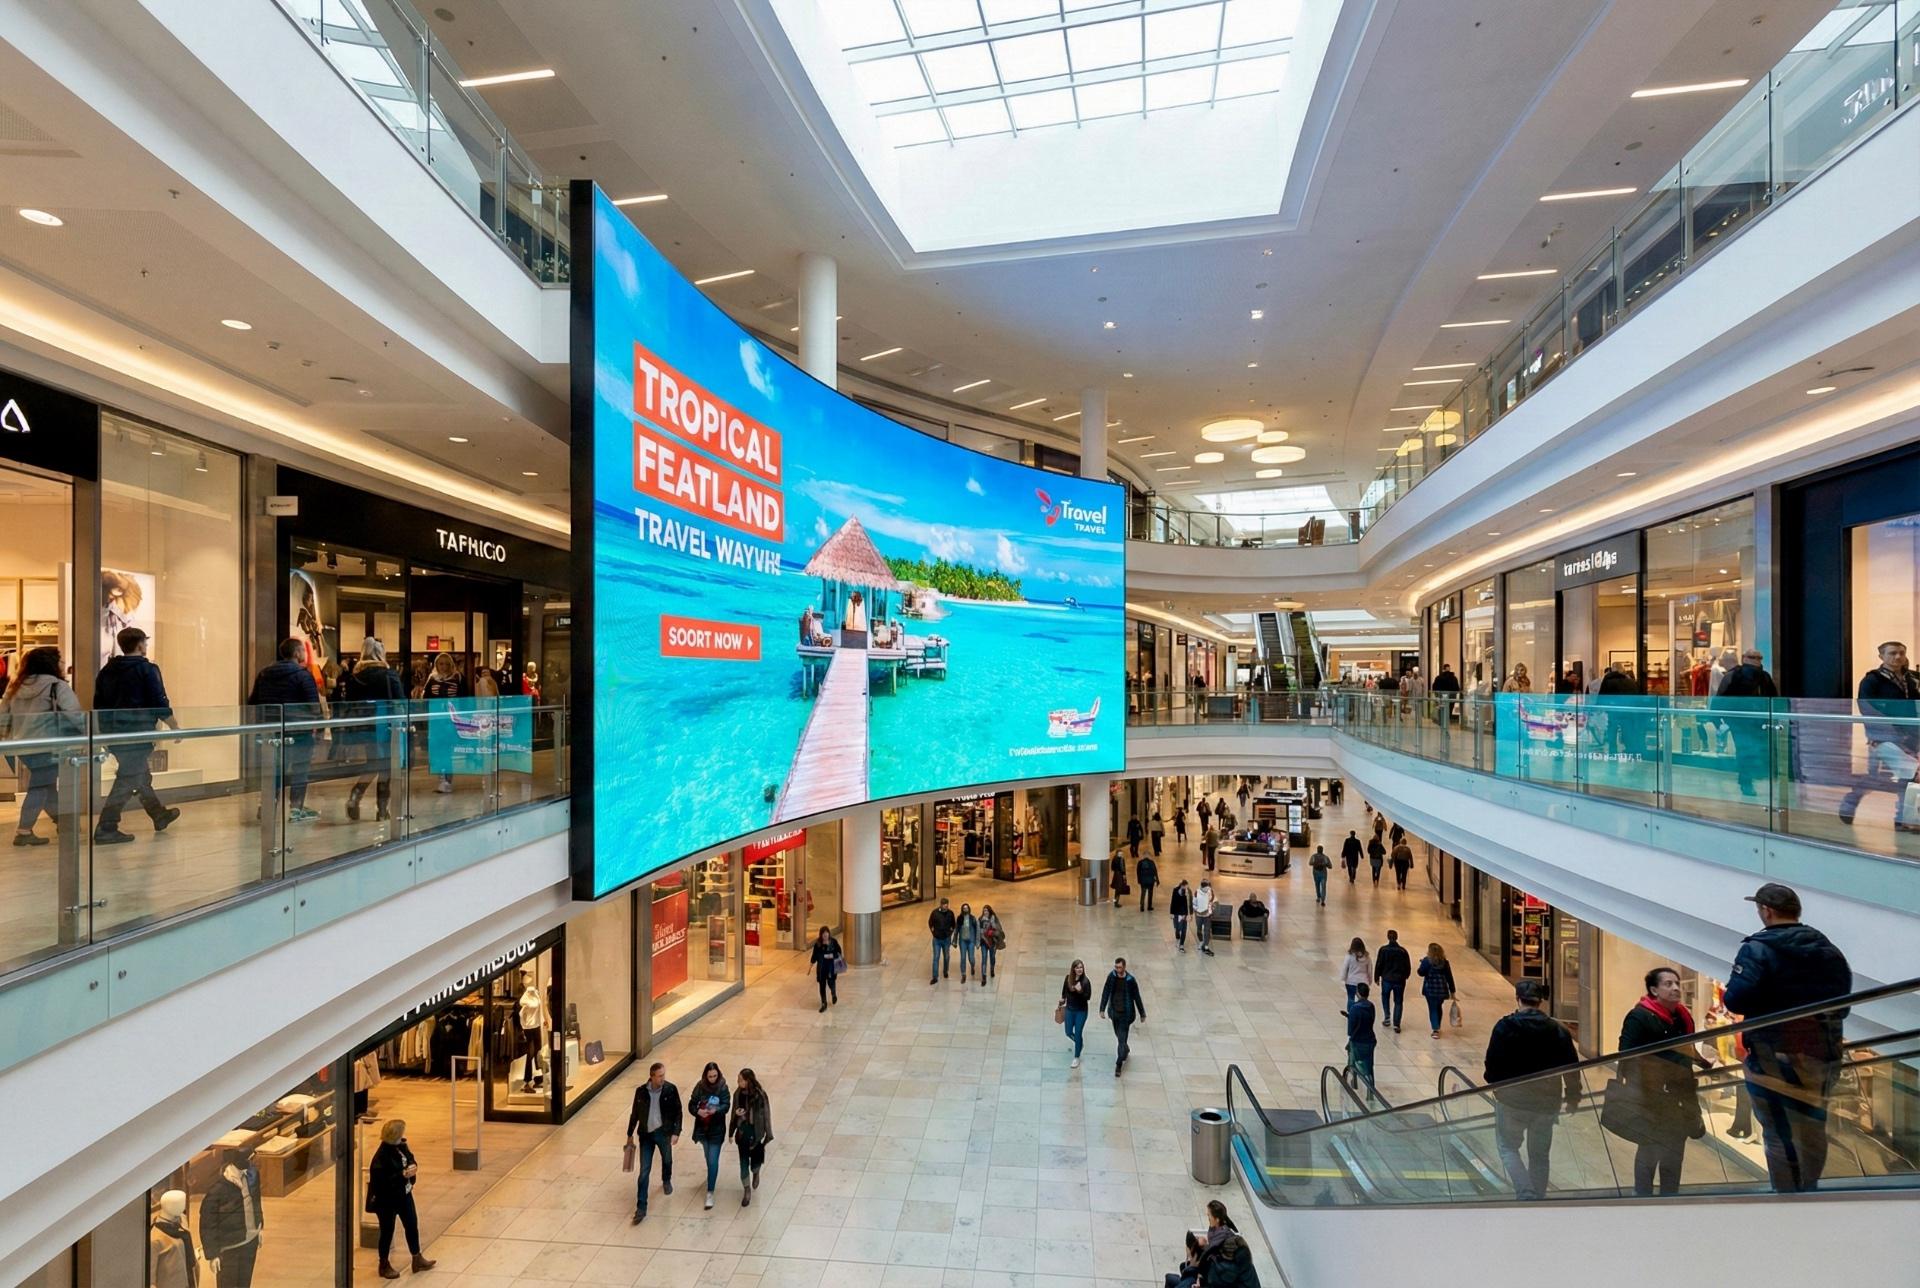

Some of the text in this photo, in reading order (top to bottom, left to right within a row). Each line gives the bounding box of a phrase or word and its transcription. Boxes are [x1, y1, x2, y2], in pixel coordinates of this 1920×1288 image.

[639, 356, 778, 477] TROPICAL
[639, 434, 780, 532] FEATLAND
[1060, 499, 1107, 525] Travel
[1074, 523, 1107, 535] TRAVEL
[635, 507, 712, 560] TRAVEL
[668, 626, 743, 651] SOORT NOW
